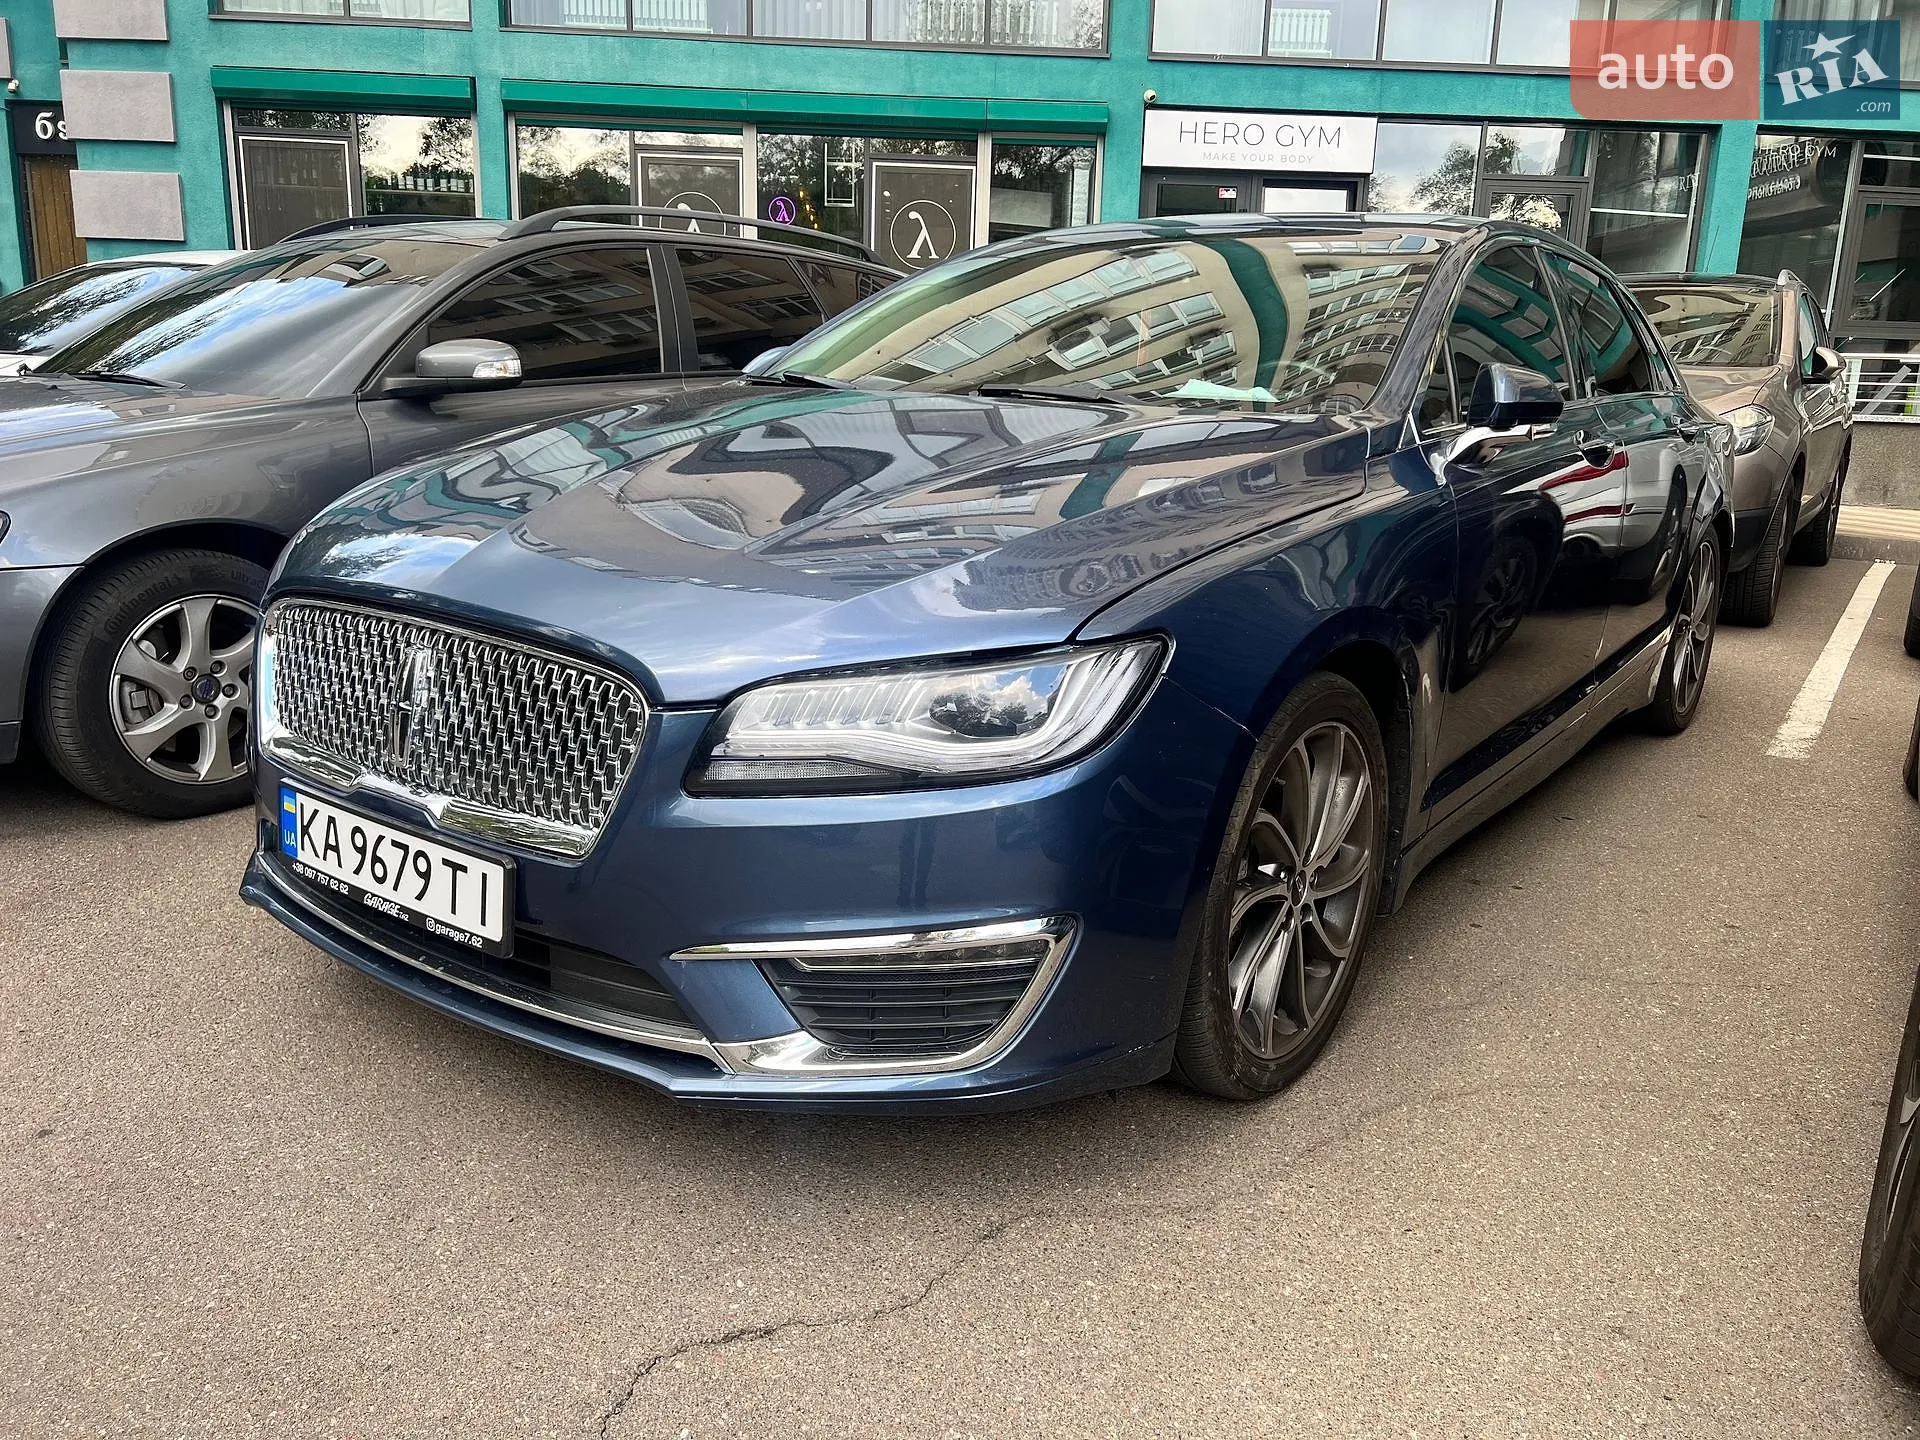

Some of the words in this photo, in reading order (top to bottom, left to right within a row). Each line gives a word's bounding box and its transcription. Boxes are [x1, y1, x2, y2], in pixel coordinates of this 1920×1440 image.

[1179, 120, 1265, 146] HERO
[1275, 124, 1341, 148] GYM
[1202, 151, 1237, 162] MAKE
[1242, 152, 1275, 163] YOUR
[1280, 154, 1314, 164] BODY
[284, 829, 297, 848] UA
[292, 862, 304, 874] +38
[304, 866, 316, 880] 097
[317, 871, 330, 885] 757
[330, 877, 339, 891] 62
[340, 882, 349, 895] 62
